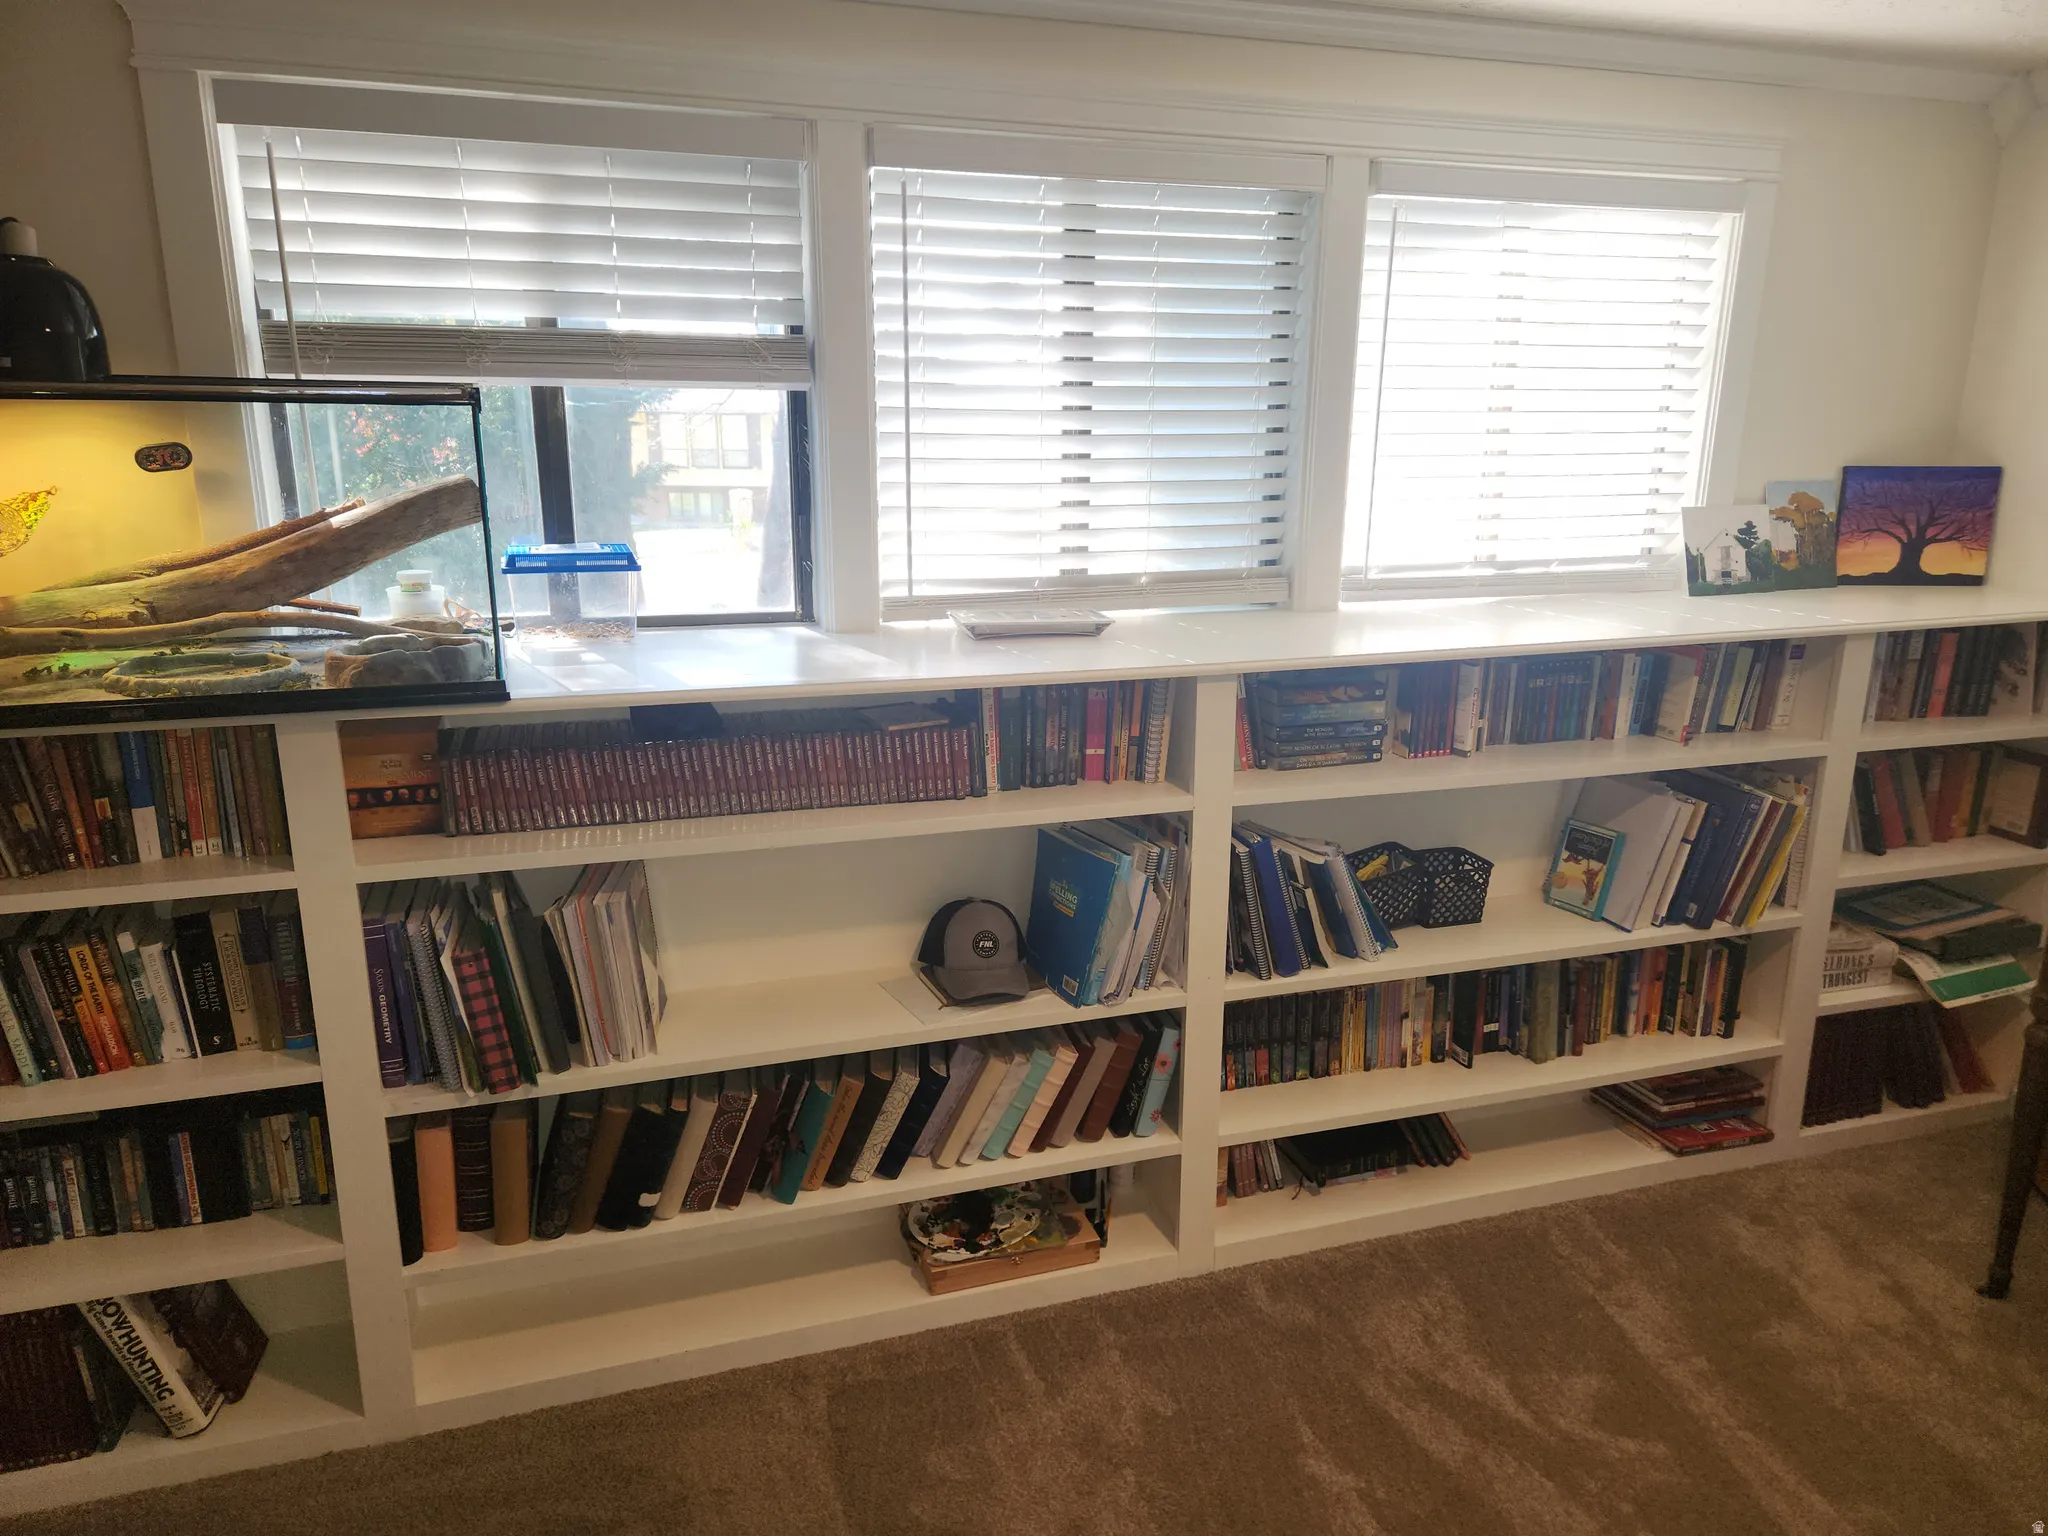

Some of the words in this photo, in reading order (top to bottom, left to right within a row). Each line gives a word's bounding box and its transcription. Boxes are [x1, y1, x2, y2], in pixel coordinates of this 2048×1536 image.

[54, 942, 70, 968] PEACE
[62, 968, 78, 993] CHILD
[76, 950, 90, 971] LORDS
[148, 952, 156, 967] WILL
[230, 951, 240, 978] COMPLETE
[83, 972, 93, 981] OF
[87, 982, 99, 994] THE
[152, 967, 162, 984] THEY
[202, 961, 221, 1012] SYSTEMATIC
[282, 966, 300, 988] COME
[134, 980, 148, 1005] GREATER
[156, 984, 168, 1005] STAND
[192, 968, 208, 1010] THEOLOGY
[230, 987, 240, 1008] PRAYER
[91, 994, 104, 1015] EARTH
[372, 967, 384, 992] SAXON
[378, 994, 393, 1044] GEOMETRY
[100, 1015, 118, 1056] RICHARDSON
[66, 1168, 74, 1186] LAST
[184, 1162, 197, 1205] CHIPMUNKS
[3, 1178, 18, 1209] SMALLVILLE
[95, 1297, 175, 1403] BOWHUNTING
[104, 1329, 124, 1355] Records
